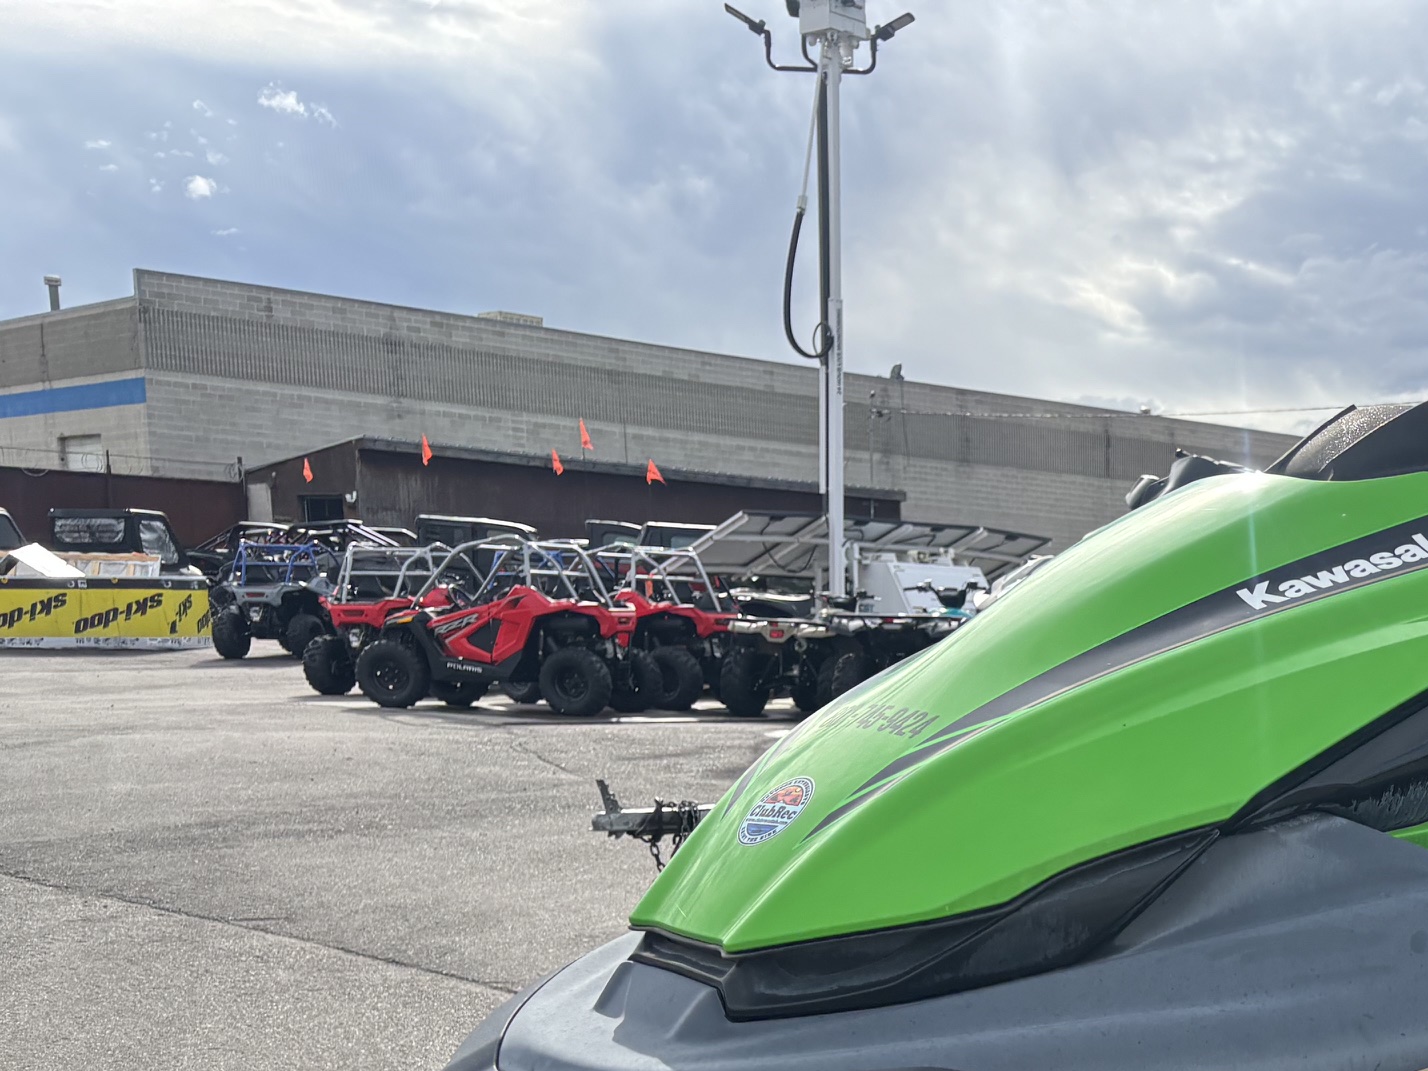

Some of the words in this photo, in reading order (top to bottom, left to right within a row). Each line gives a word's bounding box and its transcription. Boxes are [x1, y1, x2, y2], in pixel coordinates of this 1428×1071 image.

[74, 592, 163, 634] ski-doo
[447, 661, 483, 673] POLARIS
[750, 804, 797, 820] ClubRec
